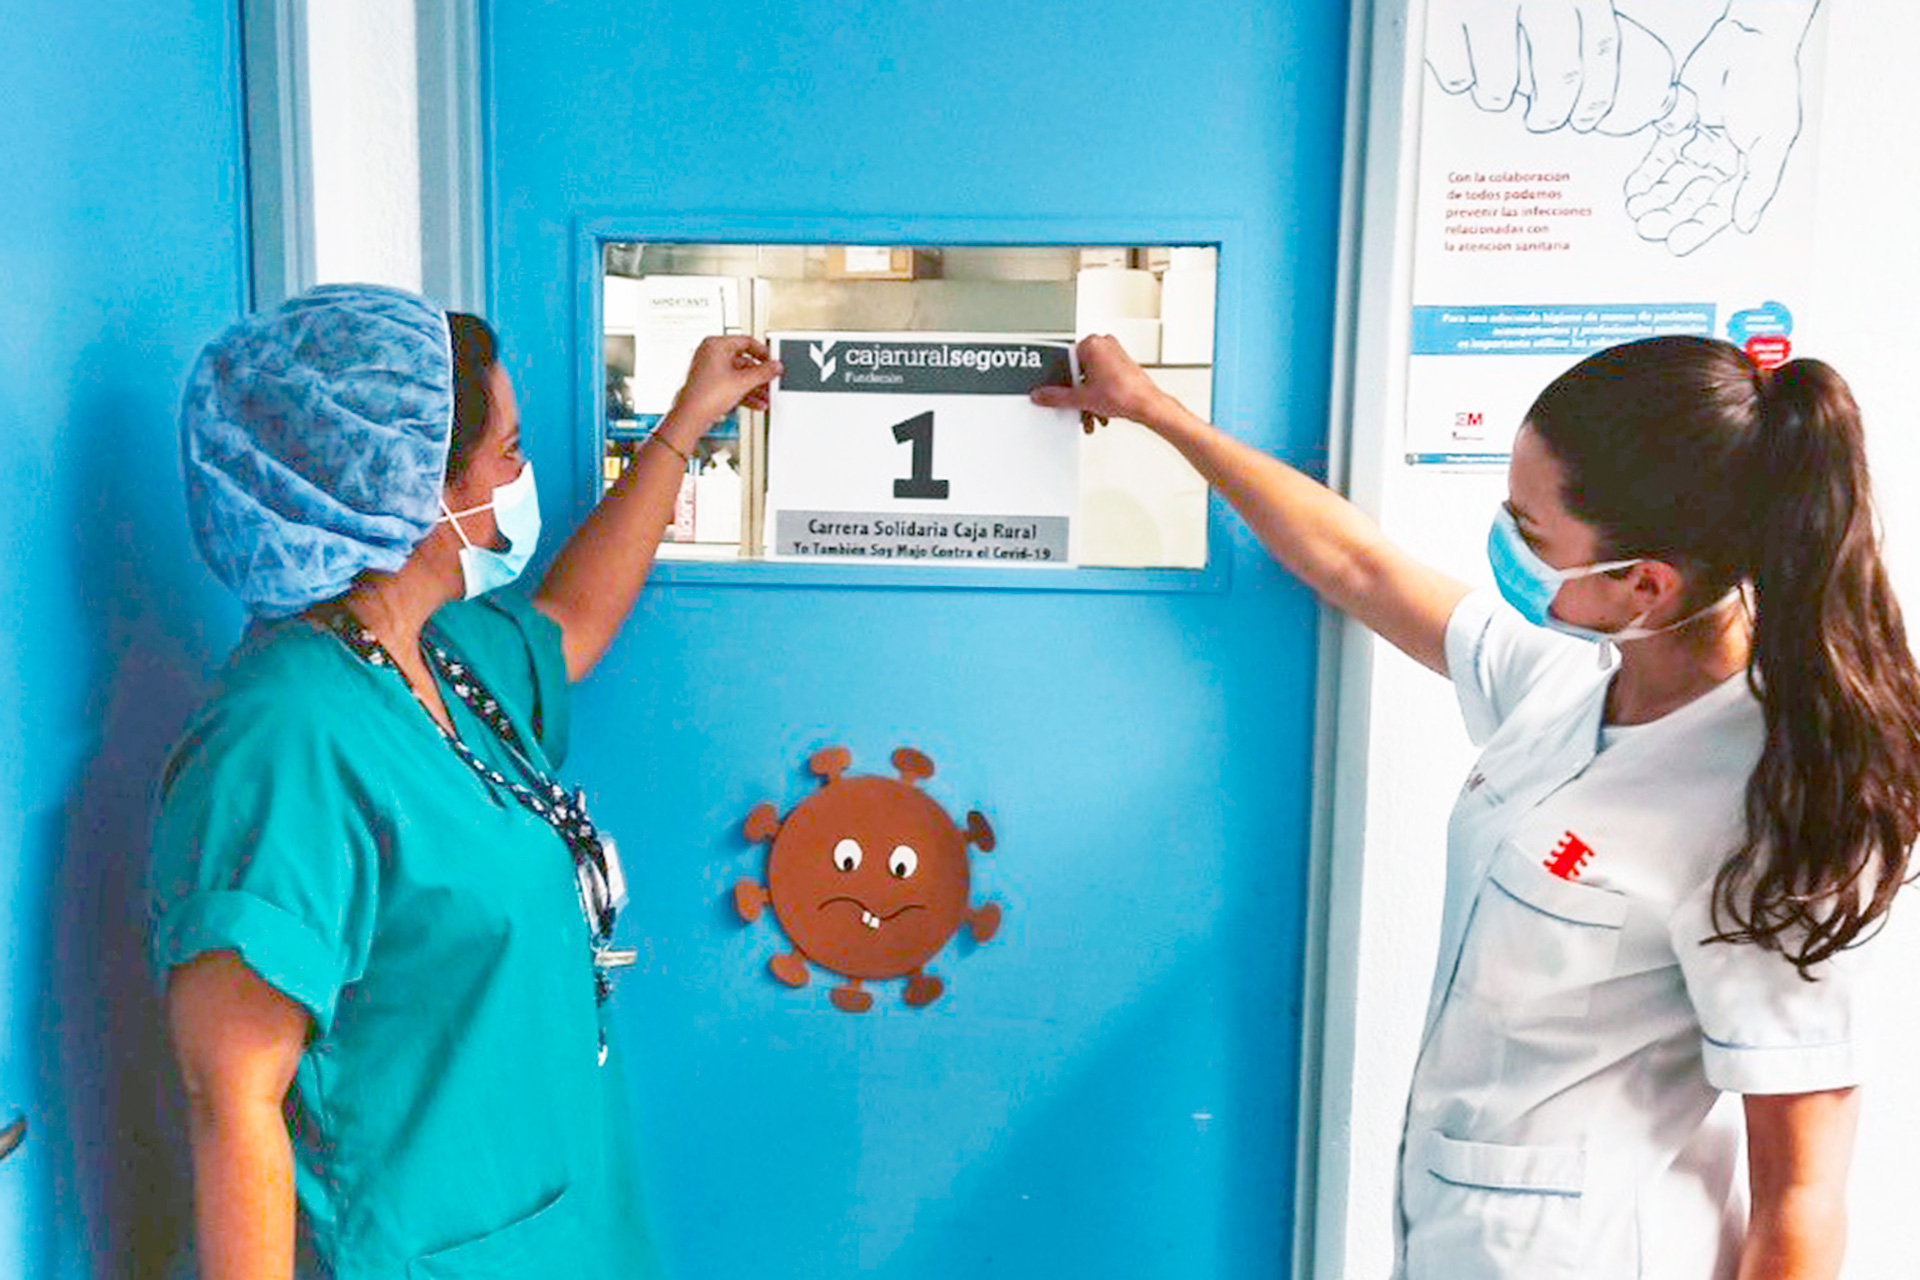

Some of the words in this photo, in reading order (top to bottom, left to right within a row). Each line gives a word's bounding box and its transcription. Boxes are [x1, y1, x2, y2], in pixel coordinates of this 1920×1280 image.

[1448, 171, 1472, 183] Con
[1465, 189, 1501, 200] todos
[1503, 188, 1563, 202] podemos
[891, 410, 950, 500] 1
[807, 518, 869, 537] Carrera
[873, 520, 948, 539] Solidaria
[953, 522, 988, 542] Caja
[993, 523, 1037, 541] Rural
[870, 544, 893, 559] Soy
[931, 545, 975, 559] Contra
[977, 546, 990, 558] el
[993, 545, 1052, 560] Covid-19
